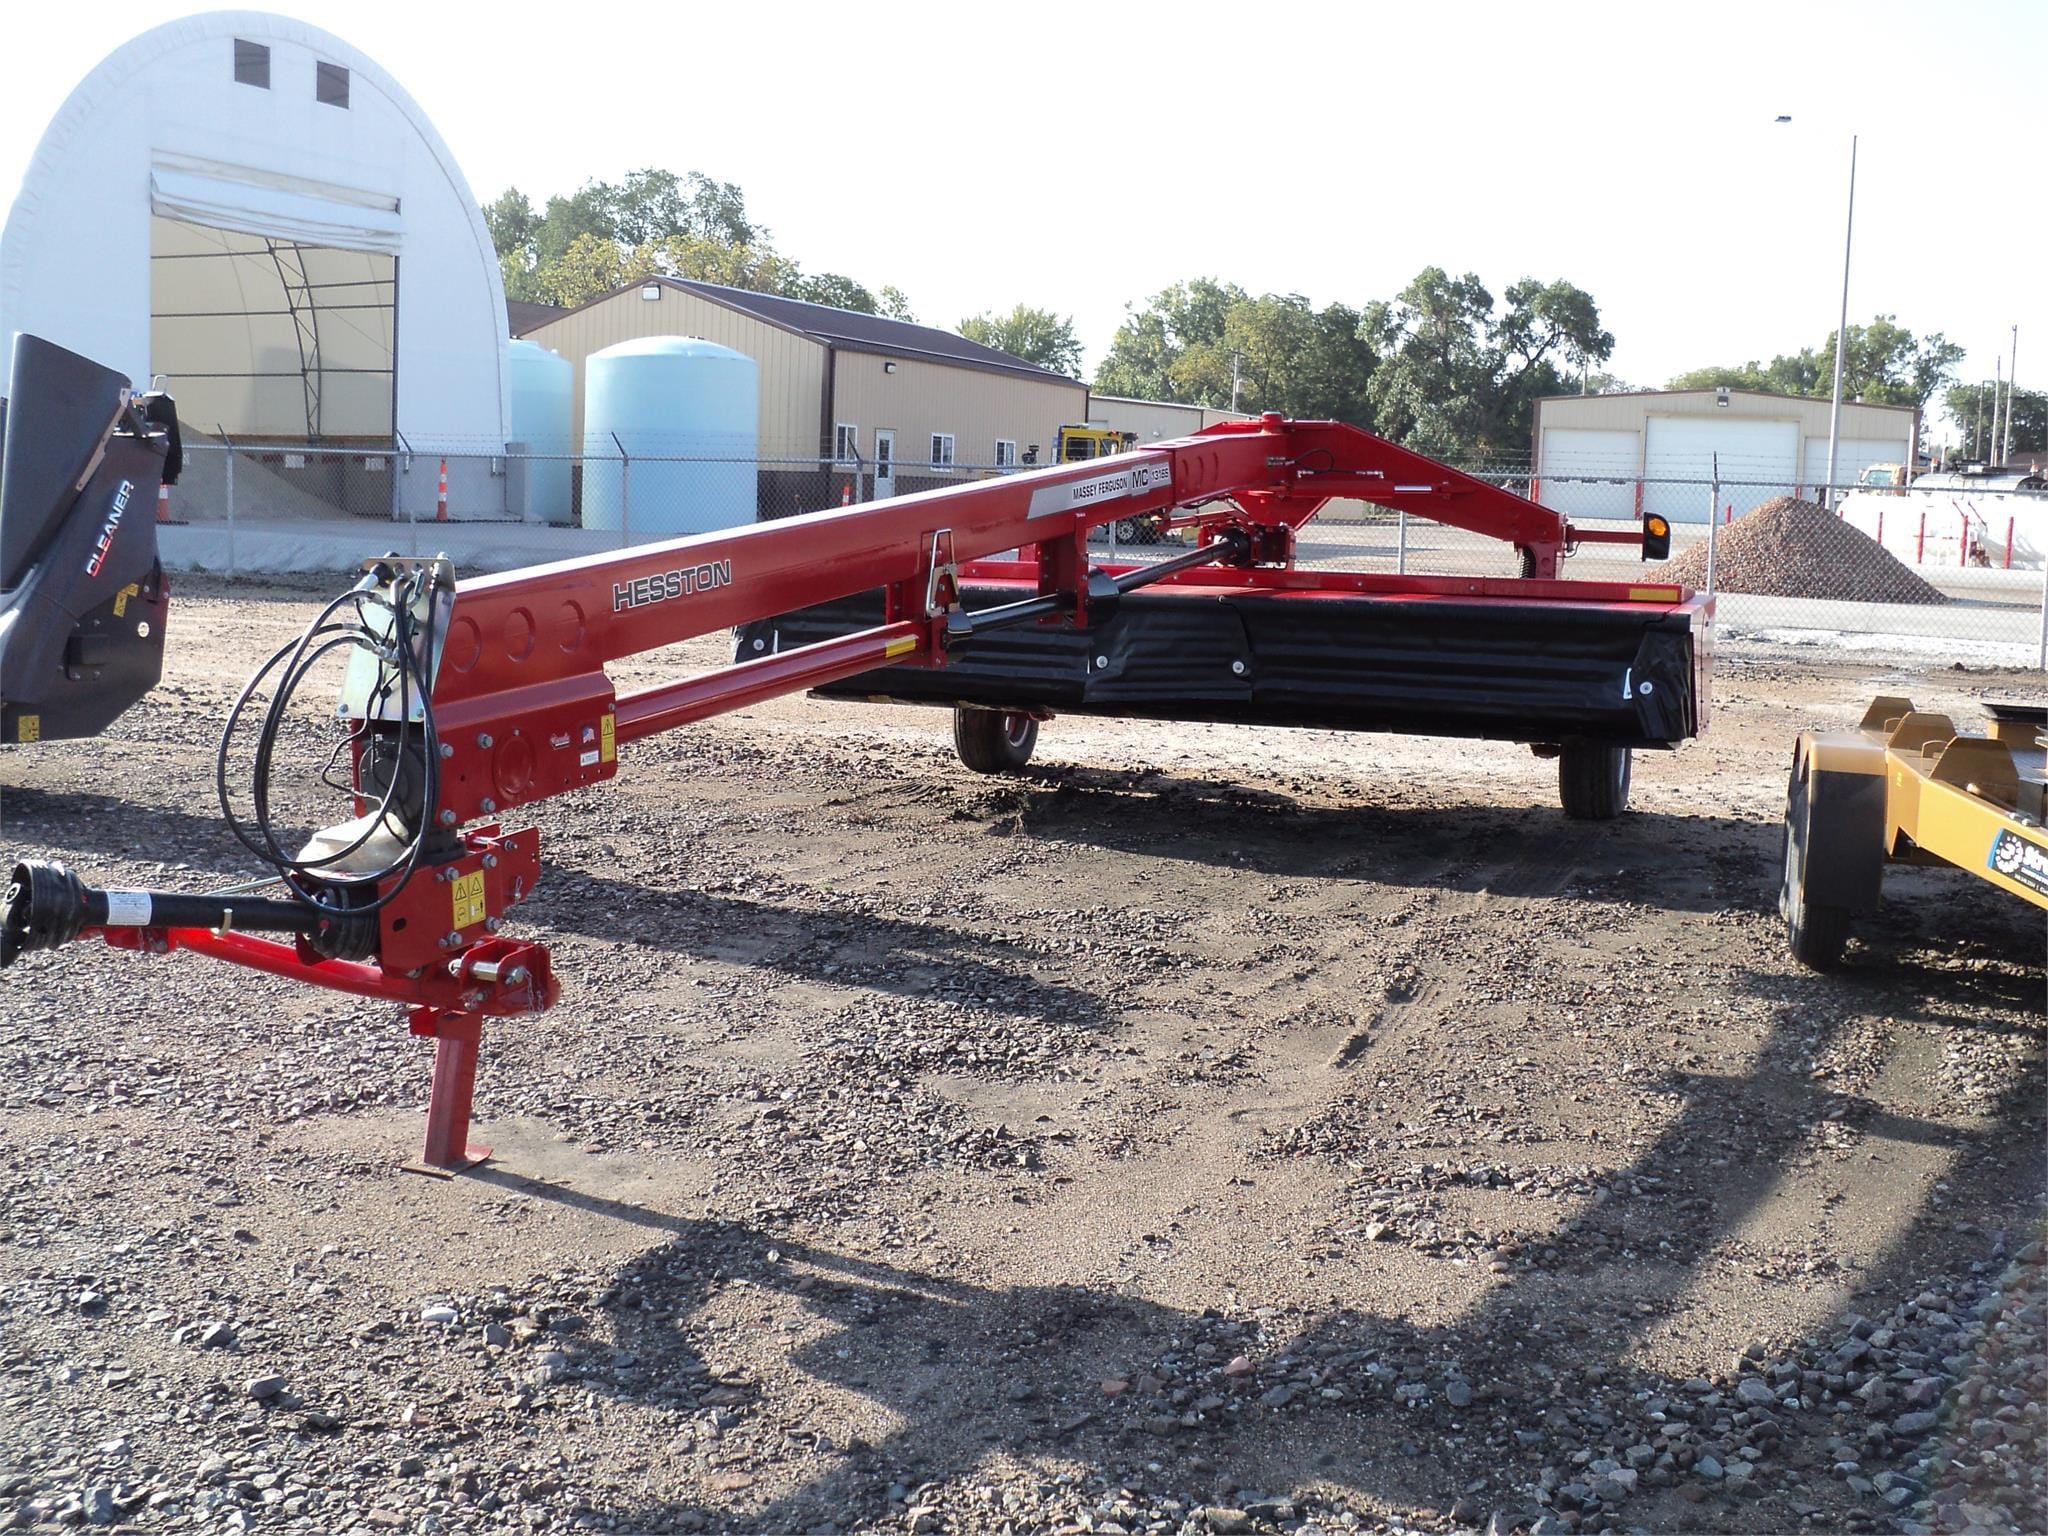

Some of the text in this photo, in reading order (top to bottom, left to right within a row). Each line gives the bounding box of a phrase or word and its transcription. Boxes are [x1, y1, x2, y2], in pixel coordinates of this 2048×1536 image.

[1072, 484, 1097, 499] MASSEY
[1098, 477, 1128, 495] FERGUSON
[1132, 469, 1148, 489] MC
[86, 480, 135, 577] CLEANER
[613, 559, 731, 611] HESSTON
